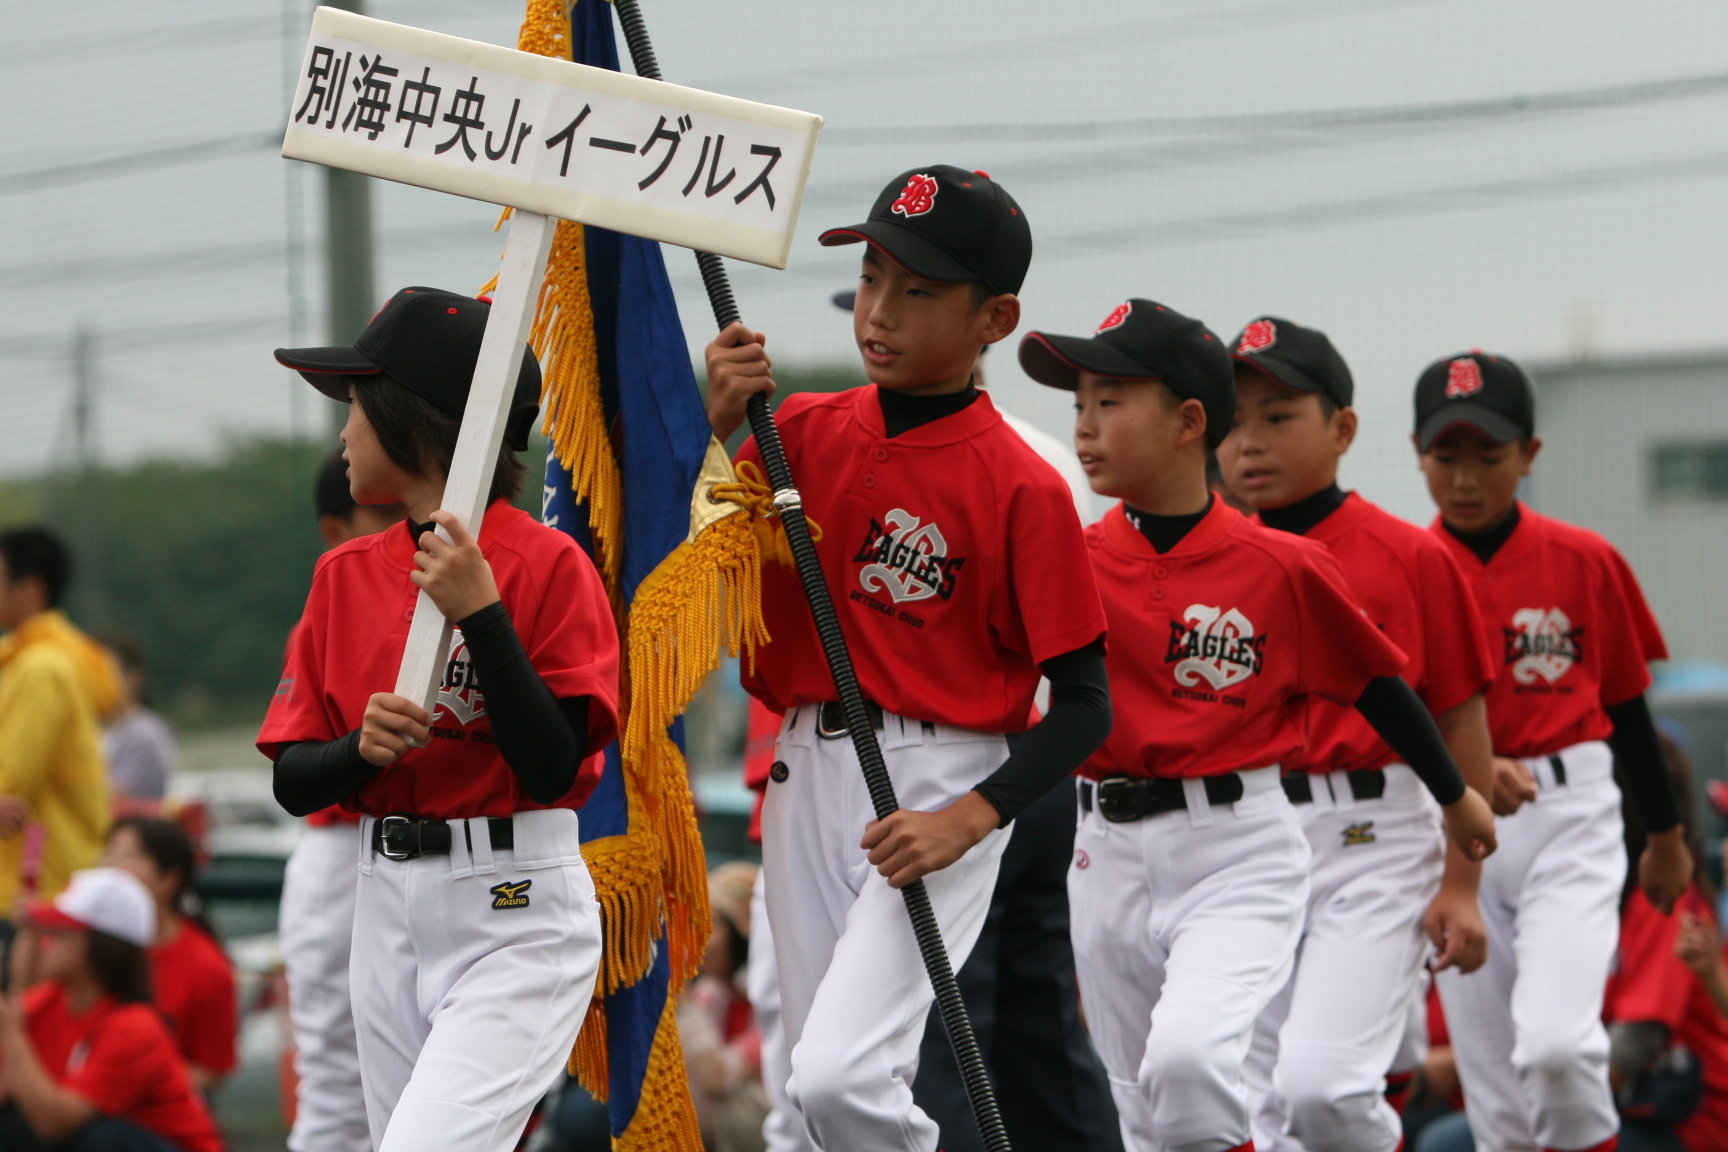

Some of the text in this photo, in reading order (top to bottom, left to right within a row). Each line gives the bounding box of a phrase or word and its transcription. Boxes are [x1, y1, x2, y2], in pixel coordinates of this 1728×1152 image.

[852, 516, 967, 601] EAGLES
[849, 590, 925, 630] BETSUKAI CHUO
[1164, 619, 1267, 677] EAGLES
[428, 726, 466, 742] TSUKAI
